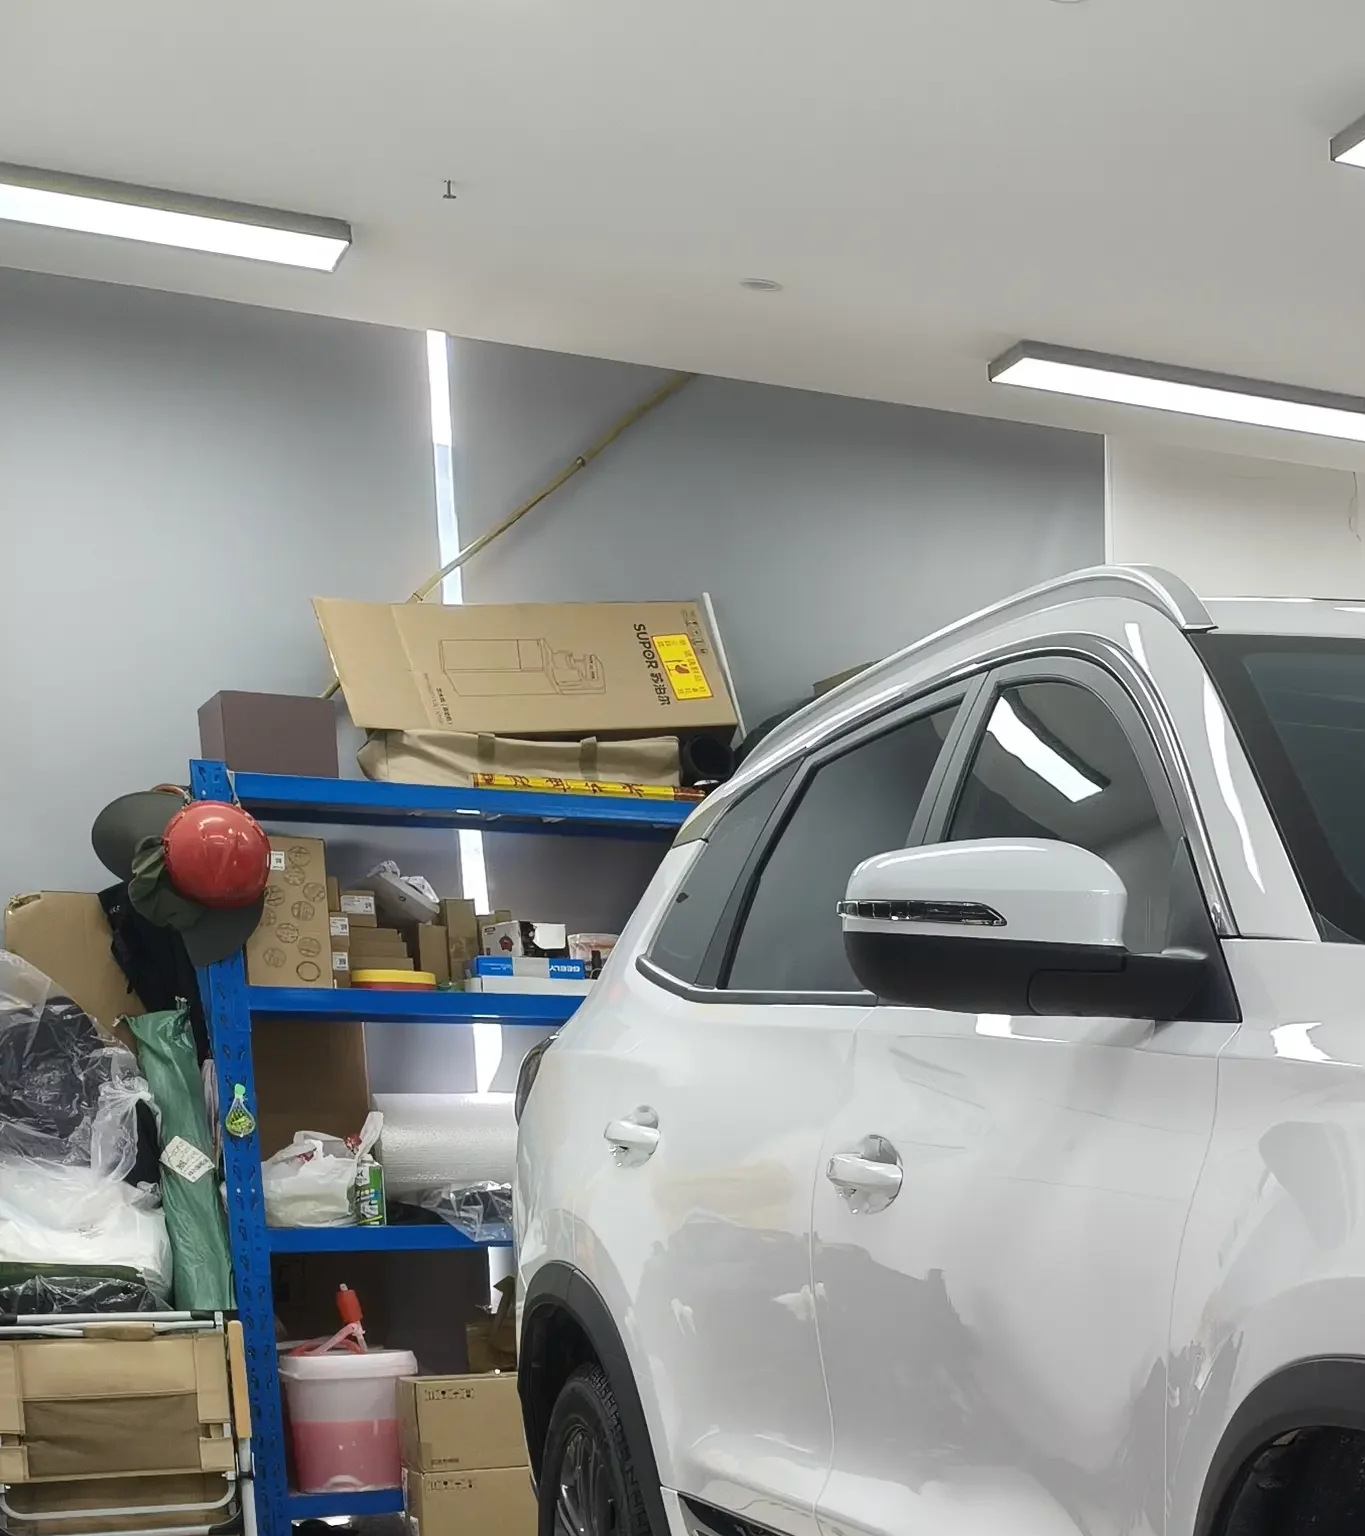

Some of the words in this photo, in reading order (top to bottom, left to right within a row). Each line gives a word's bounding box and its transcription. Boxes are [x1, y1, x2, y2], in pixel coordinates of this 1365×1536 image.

[633, 623, 659, 669] SUPOR
[650, 672, 671, 706] 苏泊尔
[549, 964, 581, 973] GEELY
